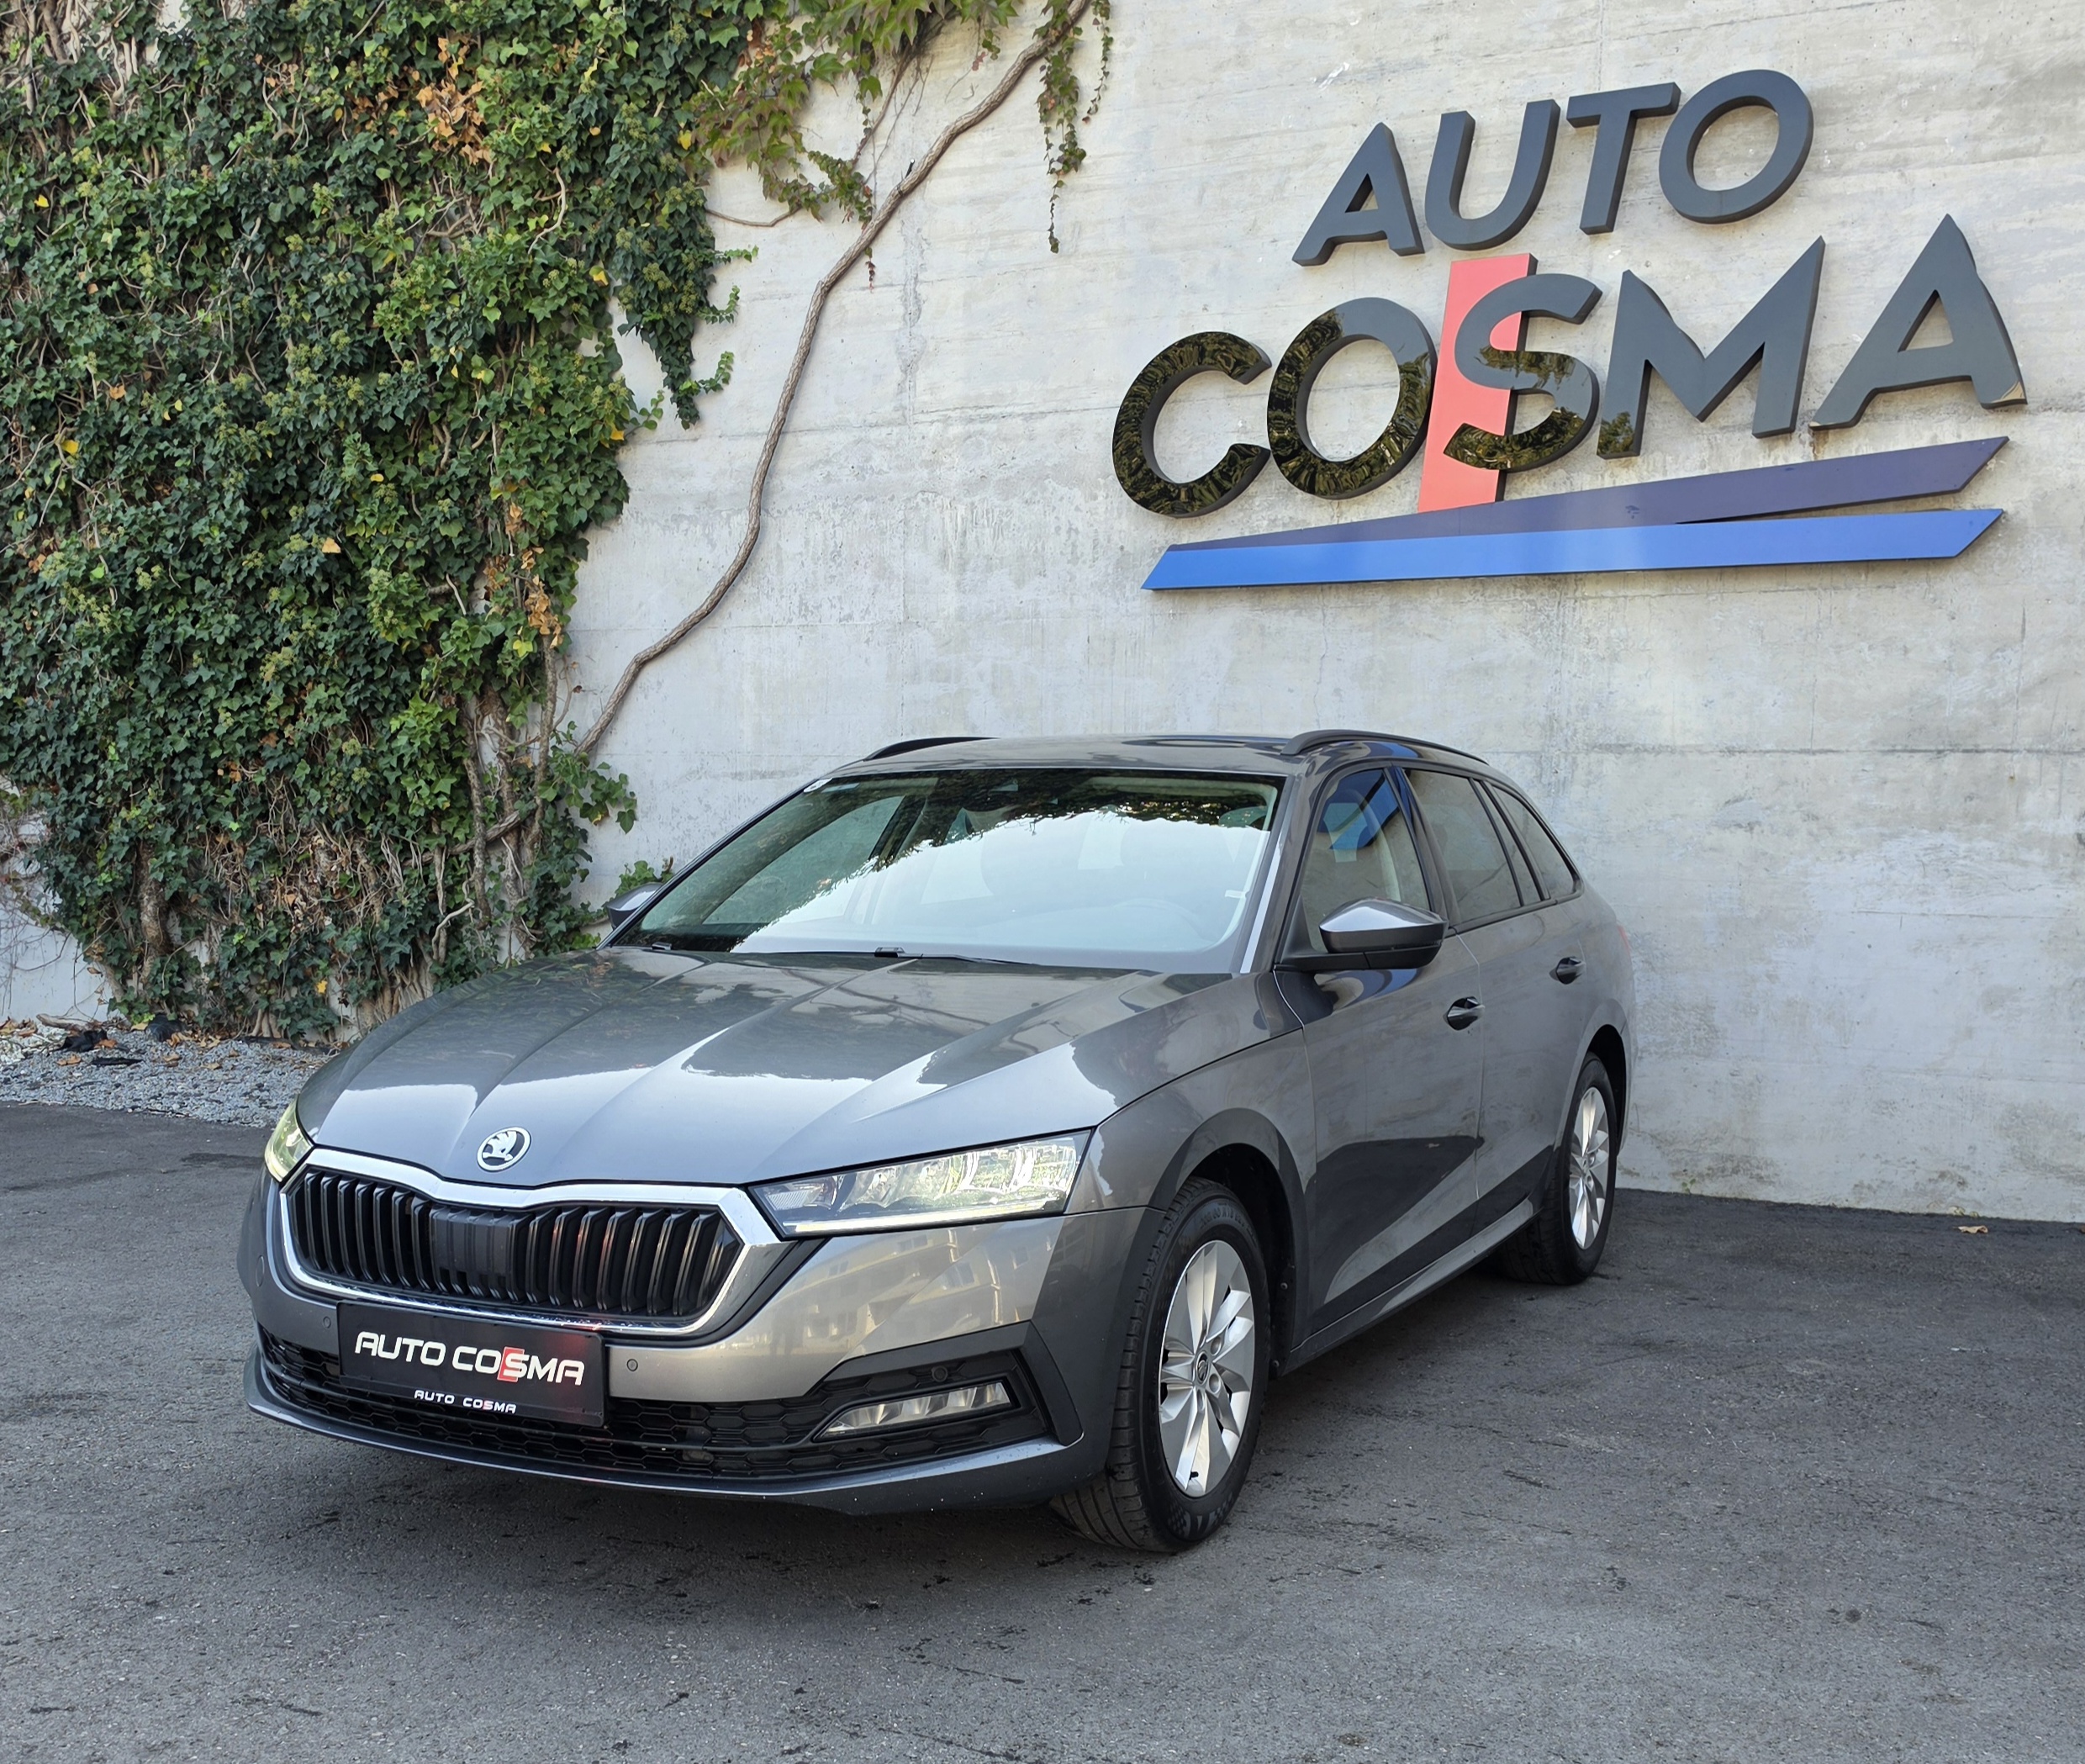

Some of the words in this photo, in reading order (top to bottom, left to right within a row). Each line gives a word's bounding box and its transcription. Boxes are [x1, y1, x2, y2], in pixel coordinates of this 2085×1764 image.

[1292, 69, 1813, 267] AUTO
[1112, 214, 2027, 518] COSMA
[355, 1331, 446, 1366] AUTO
[452, 1346, 585, 1386] COSMA
[414, 1389, 455, 1405] AUTO
[462, 1397, 517, 1414] COSMA
